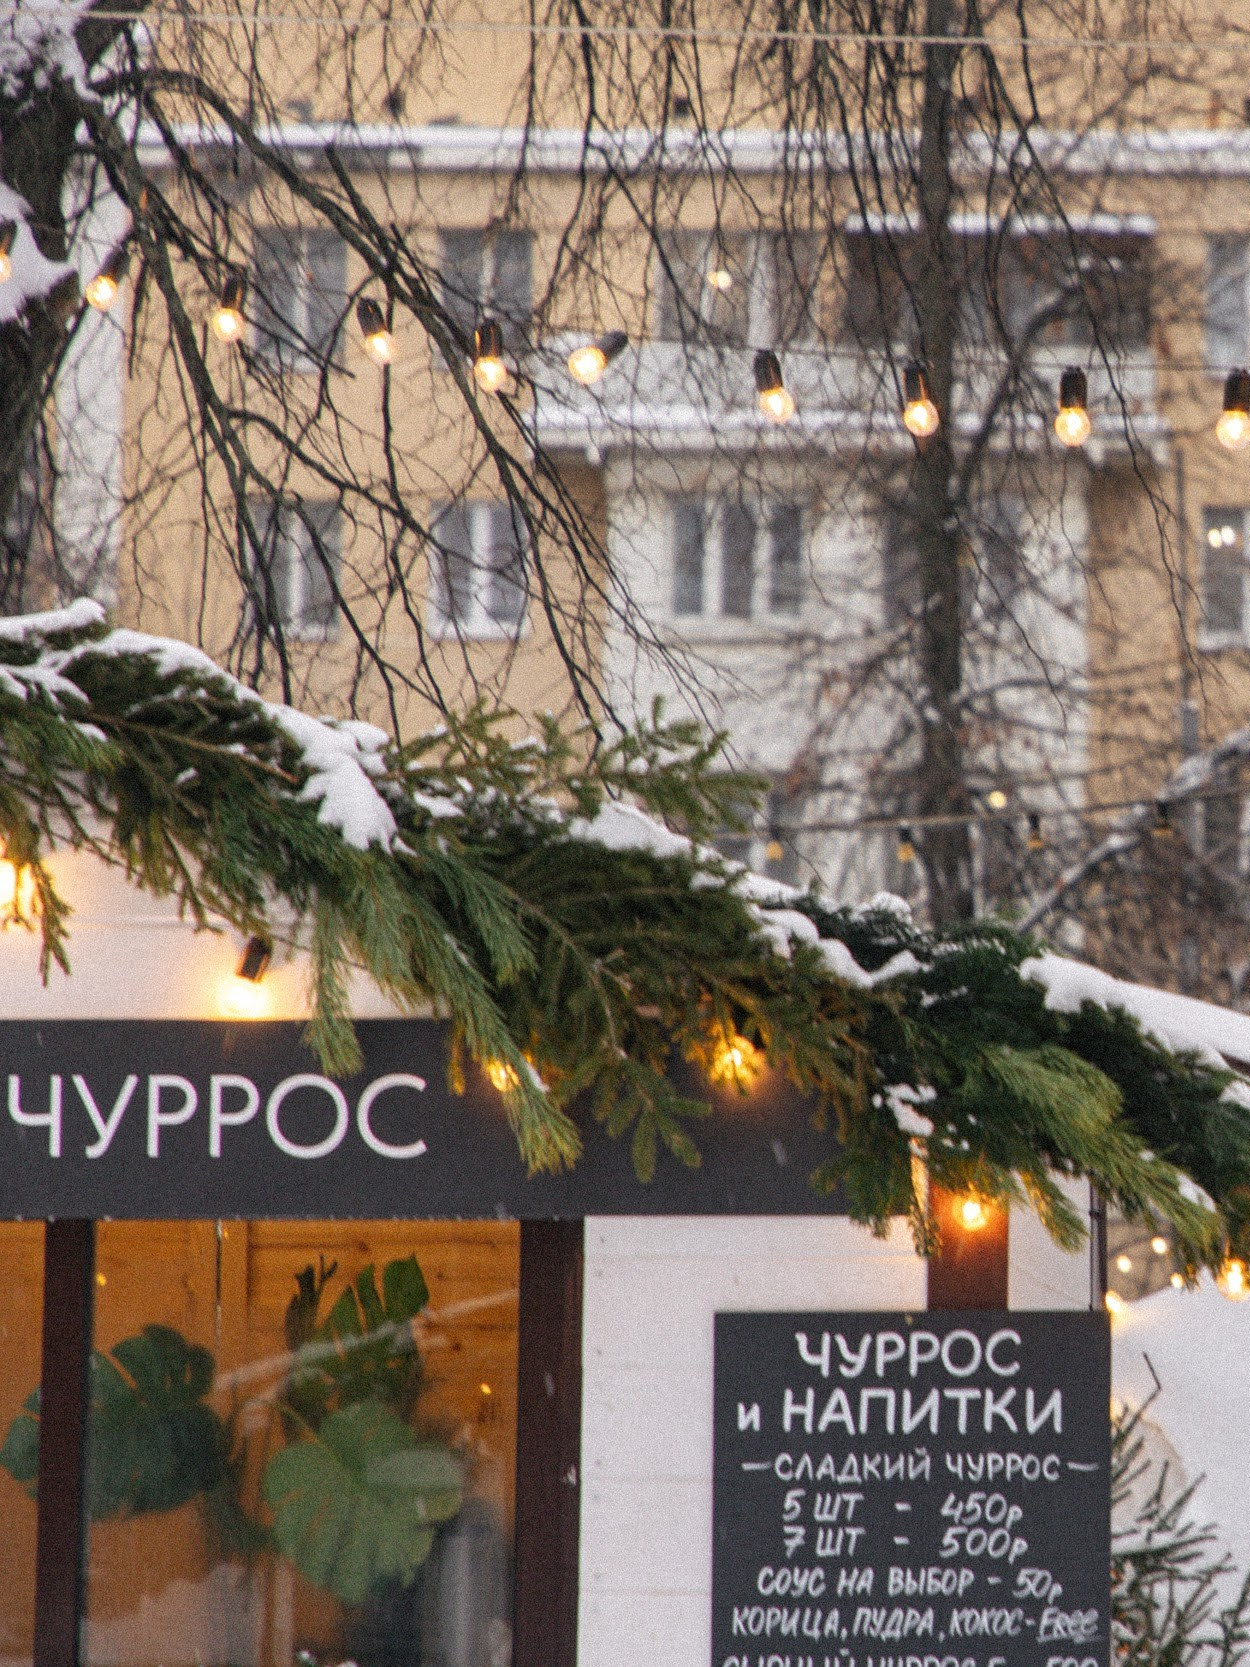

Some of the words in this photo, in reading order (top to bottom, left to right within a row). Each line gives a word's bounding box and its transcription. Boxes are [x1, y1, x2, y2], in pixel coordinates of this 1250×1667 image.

[7, 1073, 428, 1160] ЧУРРОС
[794, 1329, 1023, 1378] ЧУРРОС
[781, 1386, 1064, 1436] НАПИТКИ
[944, 1451, 1061, 1482] ЧУРРОС
[782, 1488, 806, 1521] 5
[812, 1491, 866, 1522] ШТ
[782, 1525, 807, 1557] 7
[814, 1526, 867, 1558] ШТ
[756, 1565, 827, 1598] СОУС
[835, 1566, 875, 1597] НА
[886, 1566, 976, 1597] ВЫБОР
